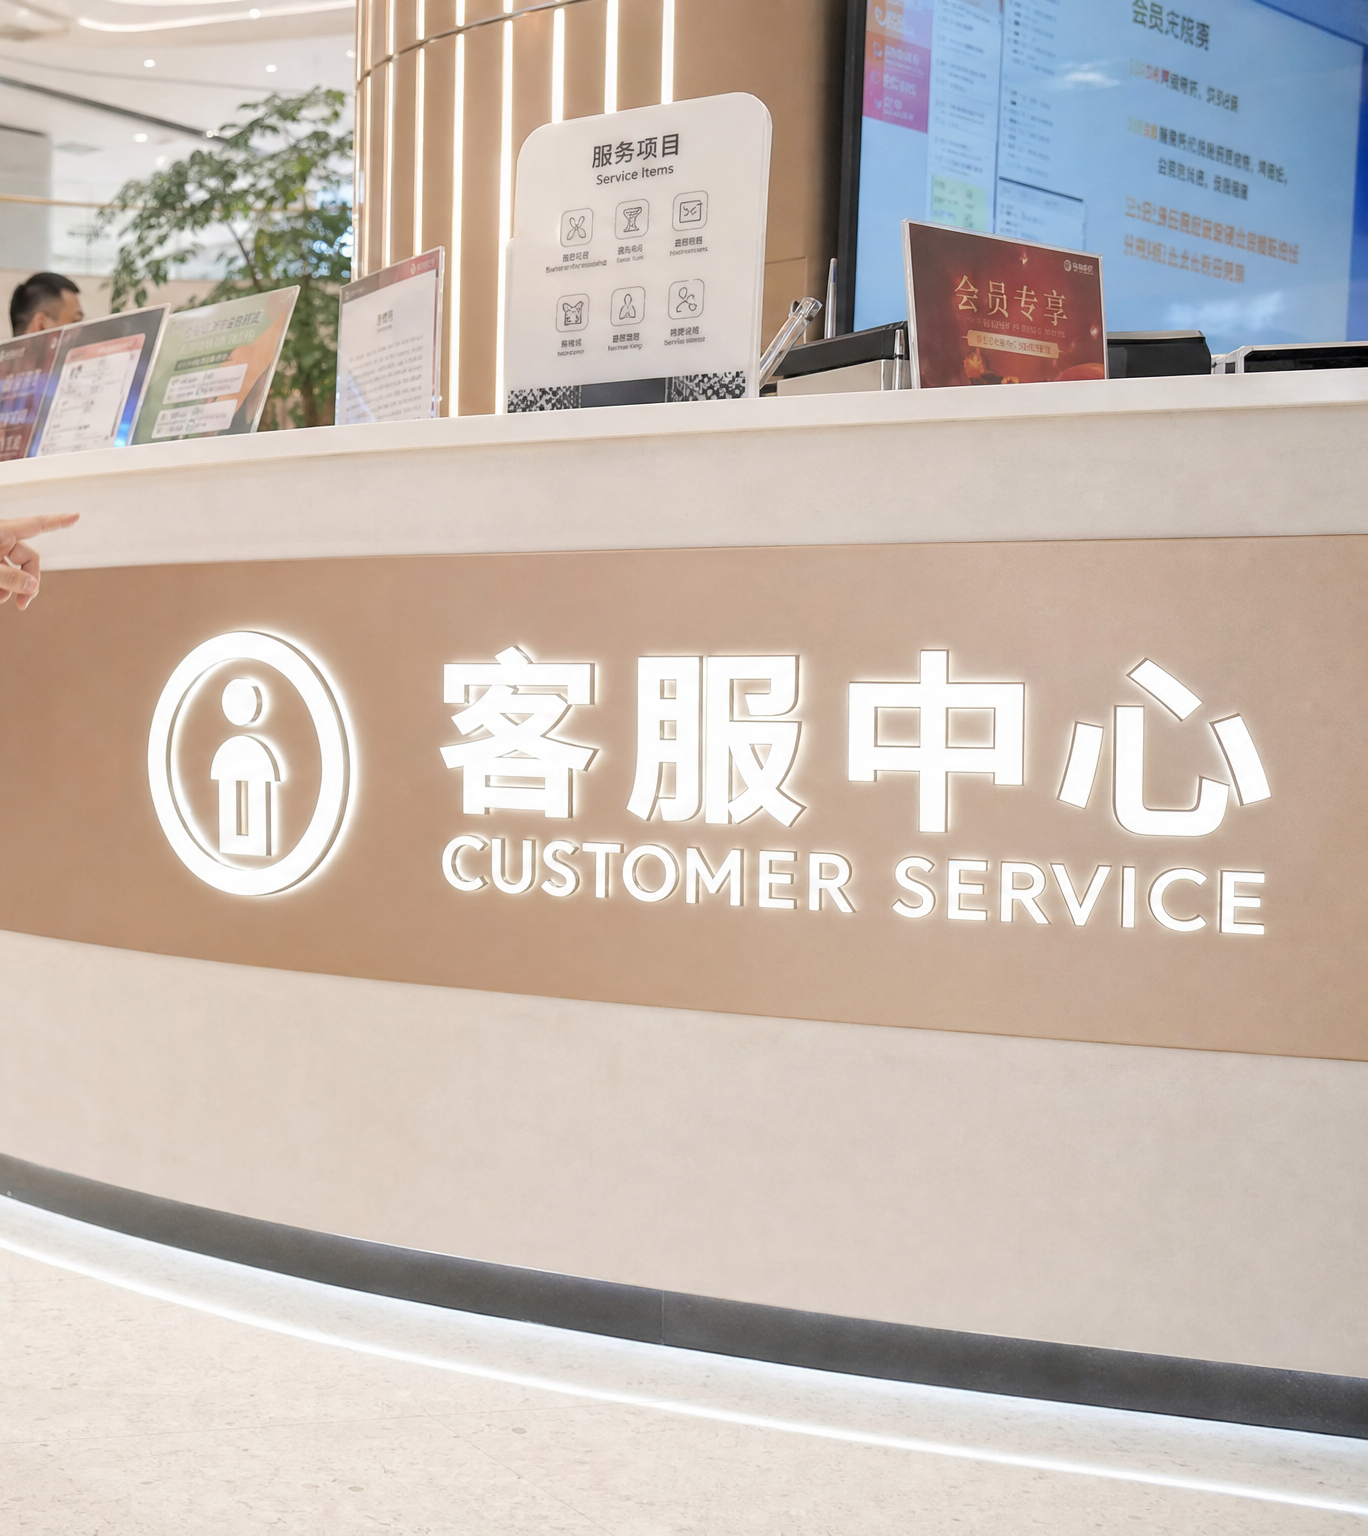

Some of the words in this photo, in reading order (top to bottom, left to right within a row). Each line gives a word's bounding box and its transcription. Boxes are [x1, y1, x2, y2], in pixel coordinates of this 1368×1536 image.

[591, 132, 679, 168] 服务项目
[595, 170, 638, 185] Service
[641, 165, 674, 178] Items
[954, 274, 1068, 326] 会员专享
[439, 645, 1272, 837] 客服中心
[441, 835, 857, 914] CUSTOMER
[891, 855, 1266, 935] SERVICE
